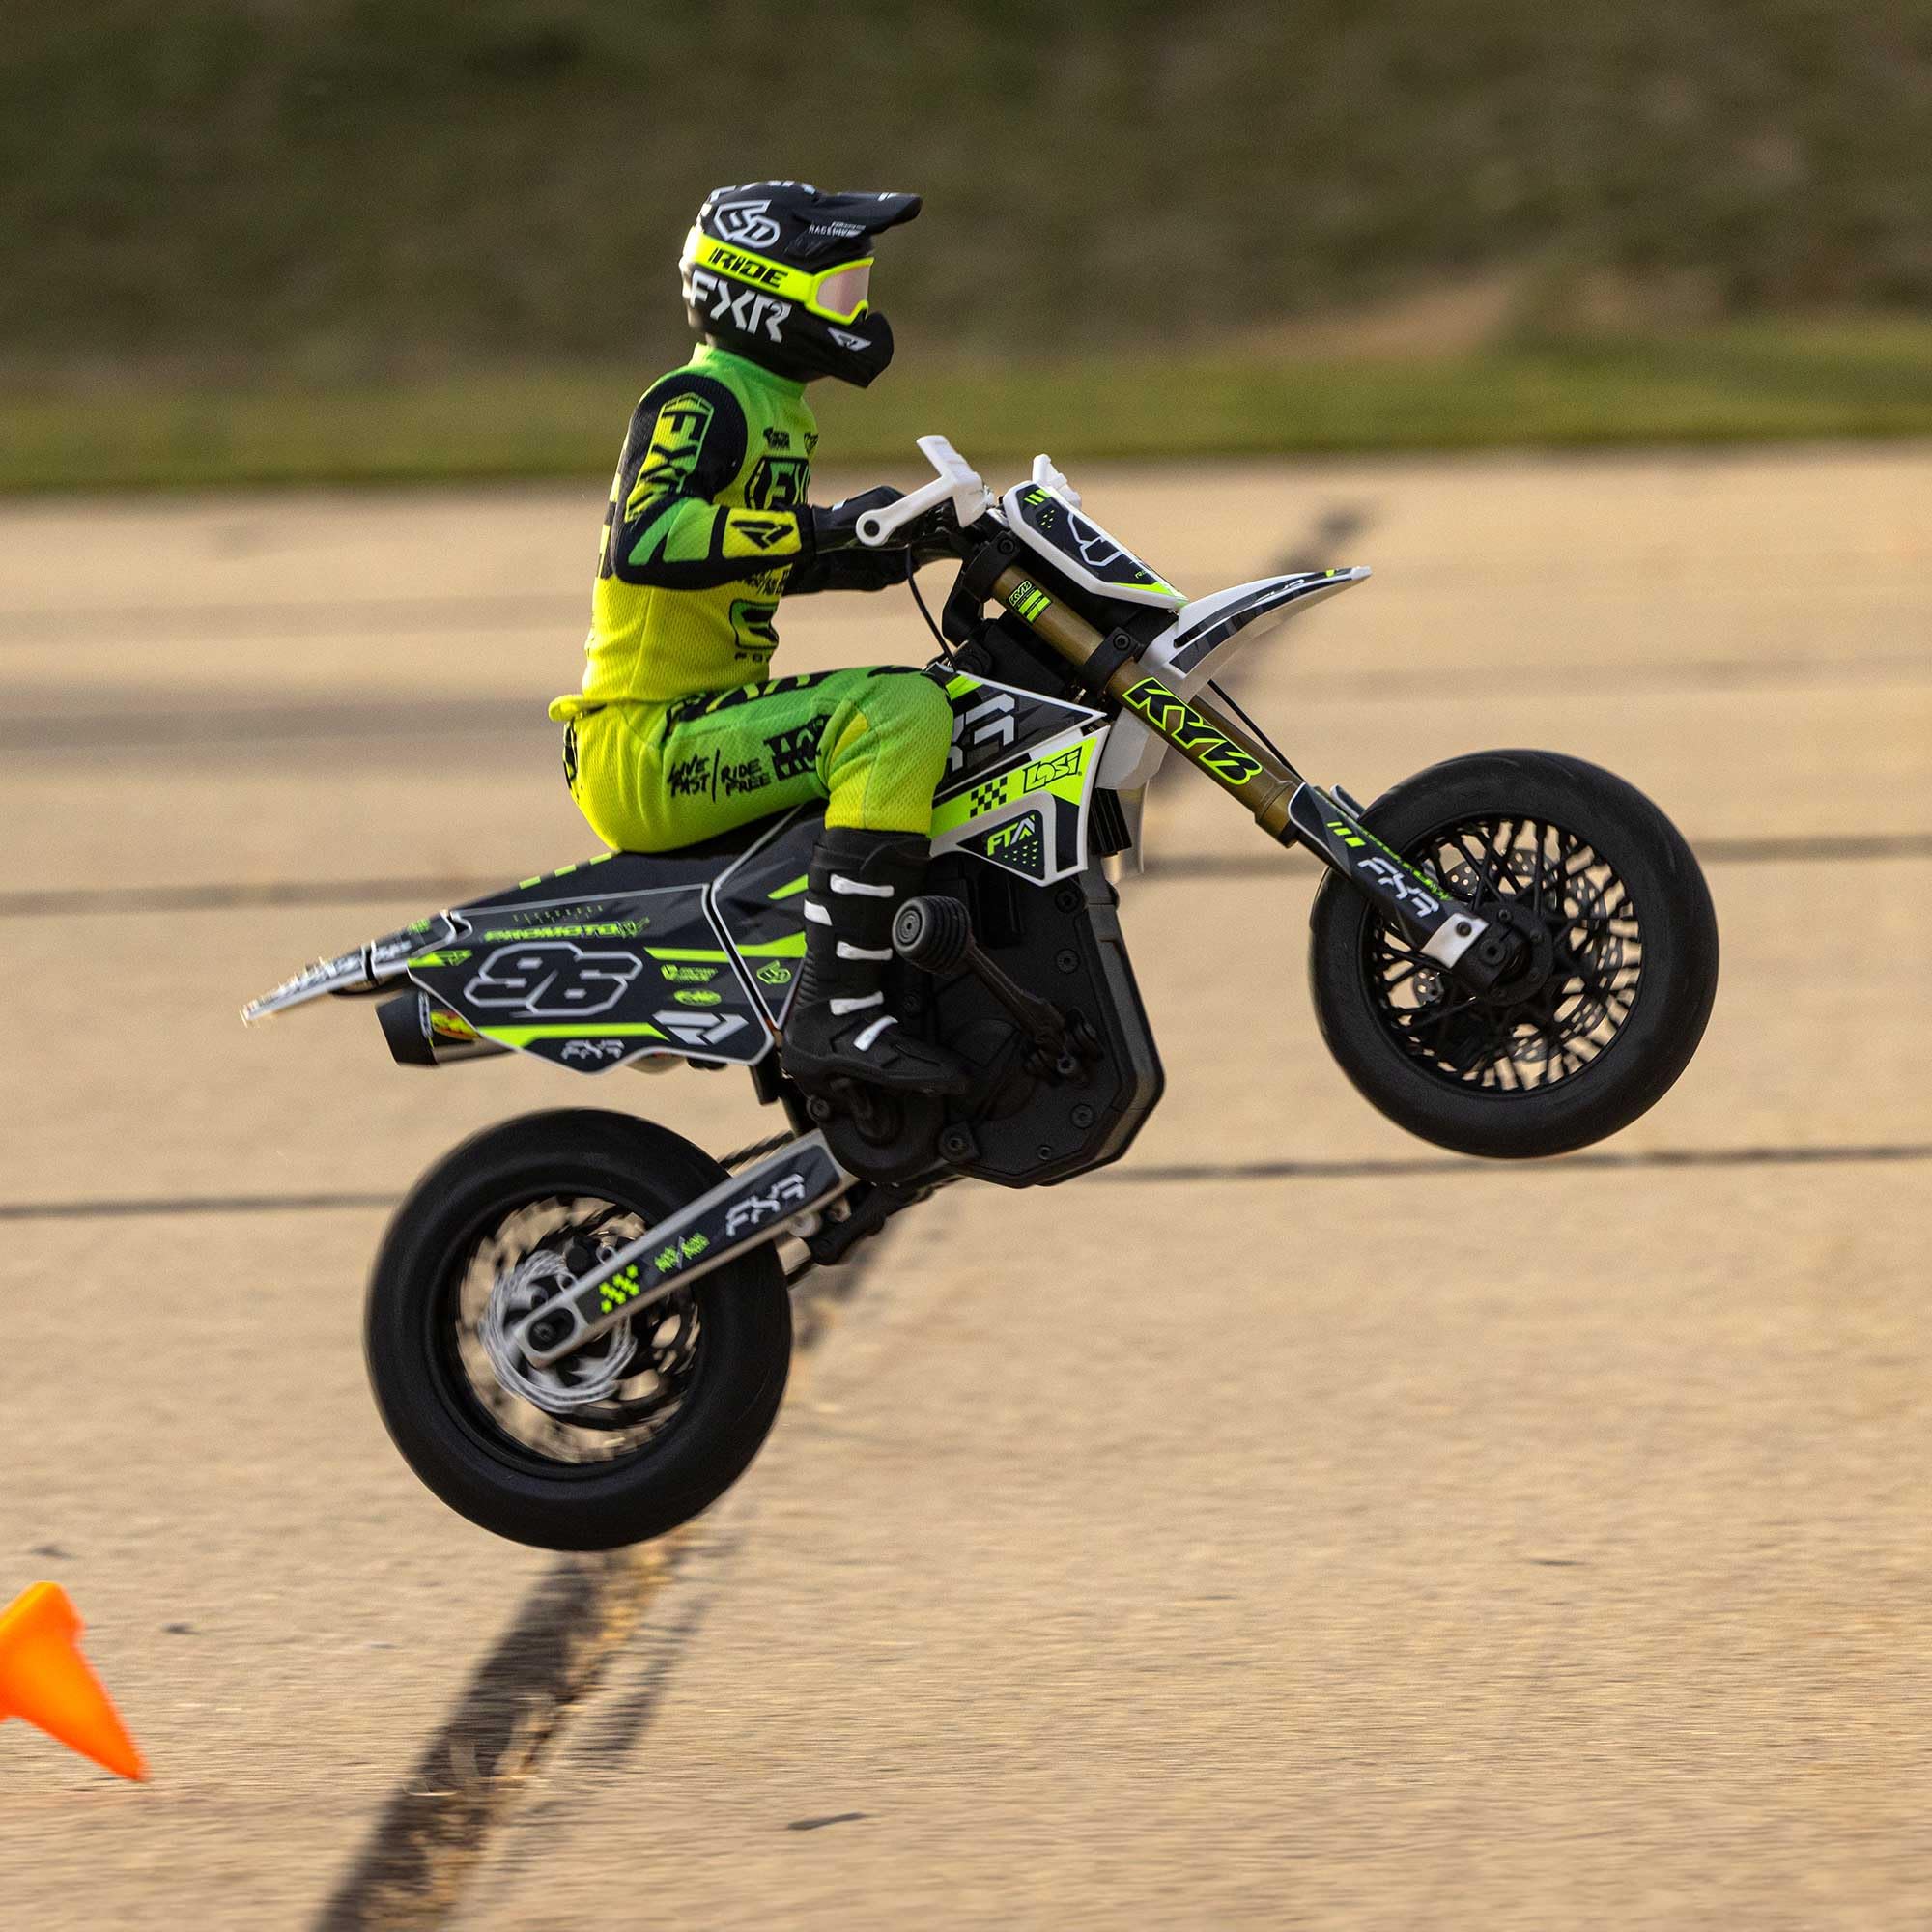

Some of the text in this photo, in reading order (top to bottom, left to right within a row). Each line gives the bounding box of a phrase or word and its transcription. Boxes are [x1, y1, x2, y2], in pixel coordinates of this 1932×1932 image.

[708, 246, 789, 290] RIDE
[689, 270, 792, 344] FXR
[1122, 677, 1262, 785] KYB
[1357, 856, 1440, 918] FXR
[463, 941, 643, 1019] 96
[560, 1039, 625, 1060] FXR
[725, 1173, 806, 1237] FXR
